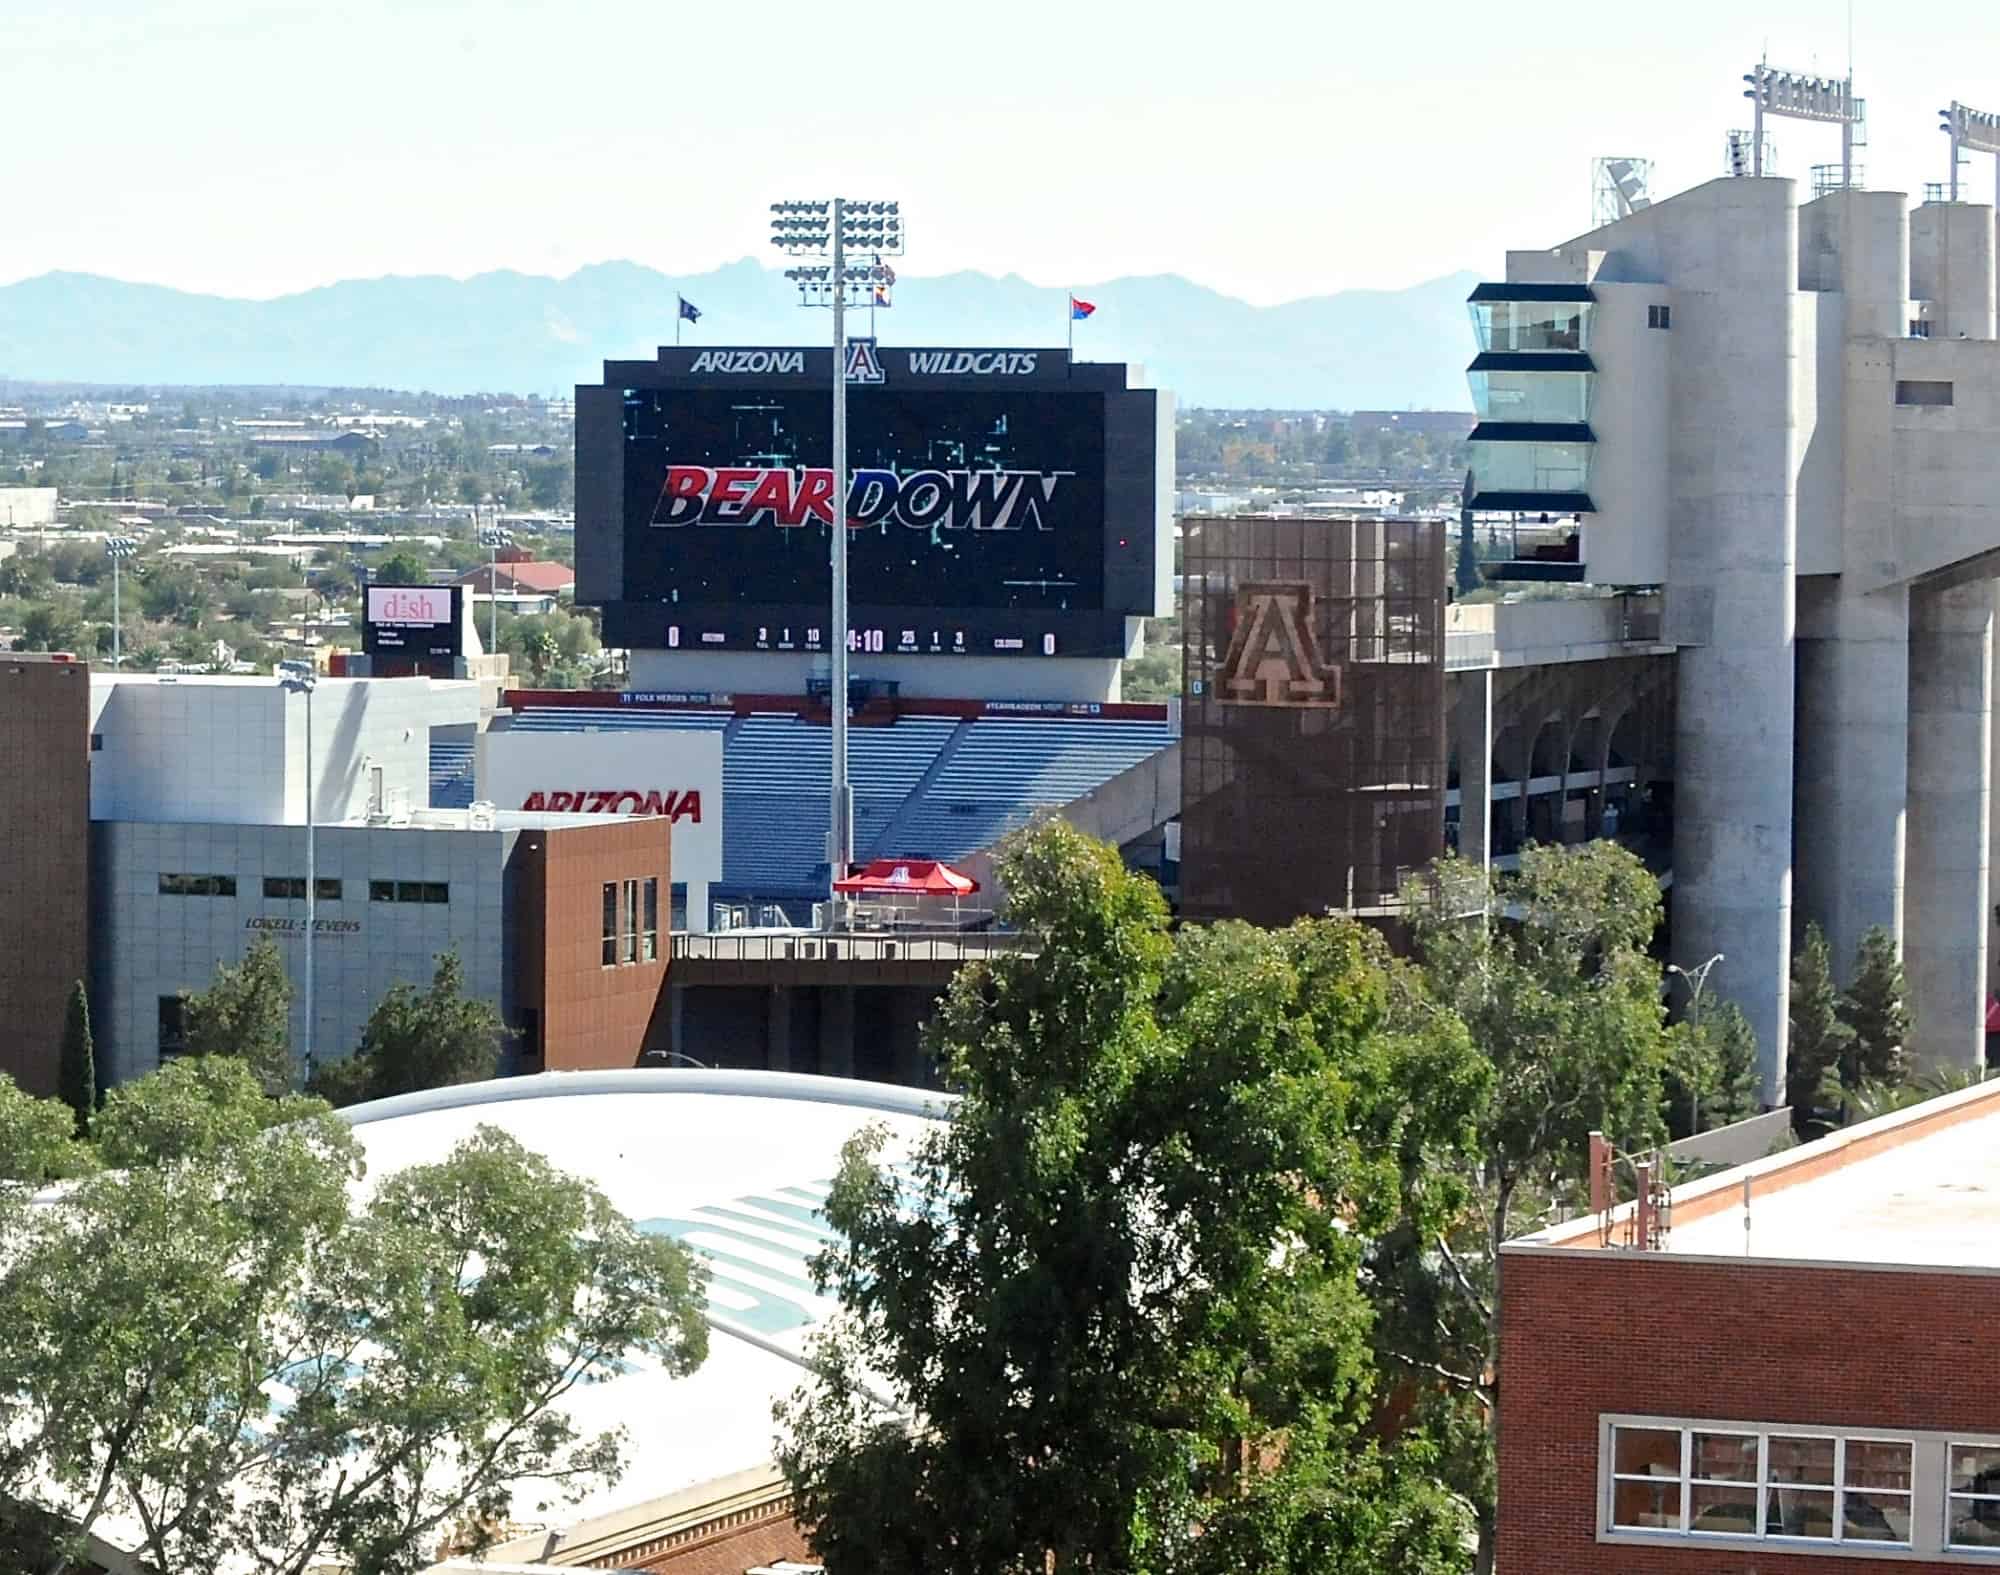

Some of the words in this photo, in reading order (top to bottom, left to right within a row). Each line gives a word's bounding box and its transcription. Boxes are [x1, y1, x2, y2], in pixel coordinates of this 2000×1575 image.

[690, 351, 804, 374] ARIZONA
[908, 353, 1036, 375] WILDCATS
[650, 465, 866, 528] BEAR
[846, 468, 1077, 531] DOWN
[383, 593, 434, 620] dish
[668, 626, 679, 648] 0
[759, 628, 767, 641] 3
[783, 628, 789, 642] 1
[807, 628, 820, 642] 10
[933, 631, 939, 645] 1
[955, 631, 964, 645] 3
[1043, 633, 1056, 655] 0
